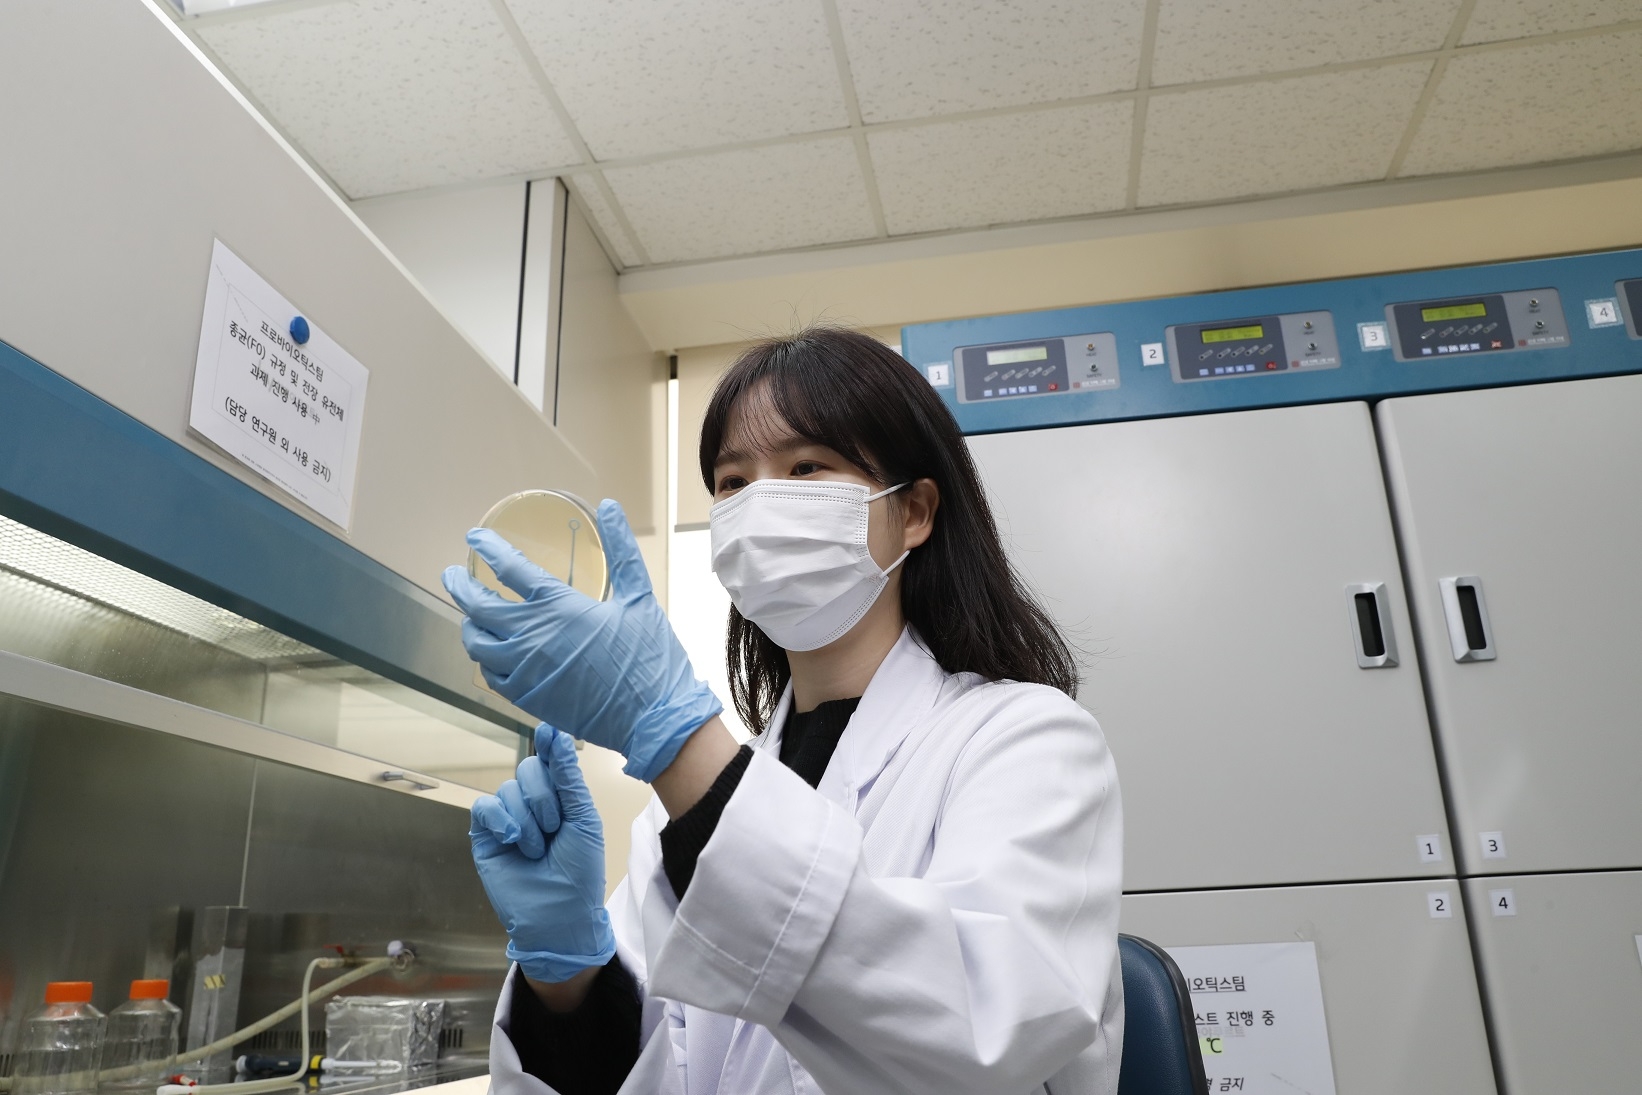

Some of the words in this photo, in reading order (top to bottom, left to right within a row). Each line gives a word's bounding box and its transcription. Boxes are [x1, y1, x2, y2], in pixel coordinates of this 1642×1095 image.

[1599, 307, 1609, 318] 4
[1370, 331, 1378, 342] 3
[260, 320, 324, 382] 프로바이오틱스팀
[1149, 349, 1157, 359] 2
[935, 371, 942, 380] 1
[250, 363, 269, 387] 과제
[271, 379, 289, 403] 진행
[292, 397, 308, 418] 사용
[269, 353, 286, 376] 규정
[290, 369, 298, 387] 및
[302, 379, 318, 401] 전장
[321, 395, 344, 422] 유전체
[225, 396, 248, 423] (담당
[251, 416, 277, 445] 연구원
[280, 437, 289, 453] 외
[292, 446, 309, 467] 사용
[312, 459, 331, 483] 금지)
[1426, 843, 1434, 855] 1
[1488, 839, 1498, 852] 3
[1435, 899, 1445, 911] 2
[1498, 897, 1508, 909] 4
[1226, 1011, 1254, 1027] 진행
[1262, 1010, 1275, 1026] 중
[1220, 1077, 1245, 1092] 금지
